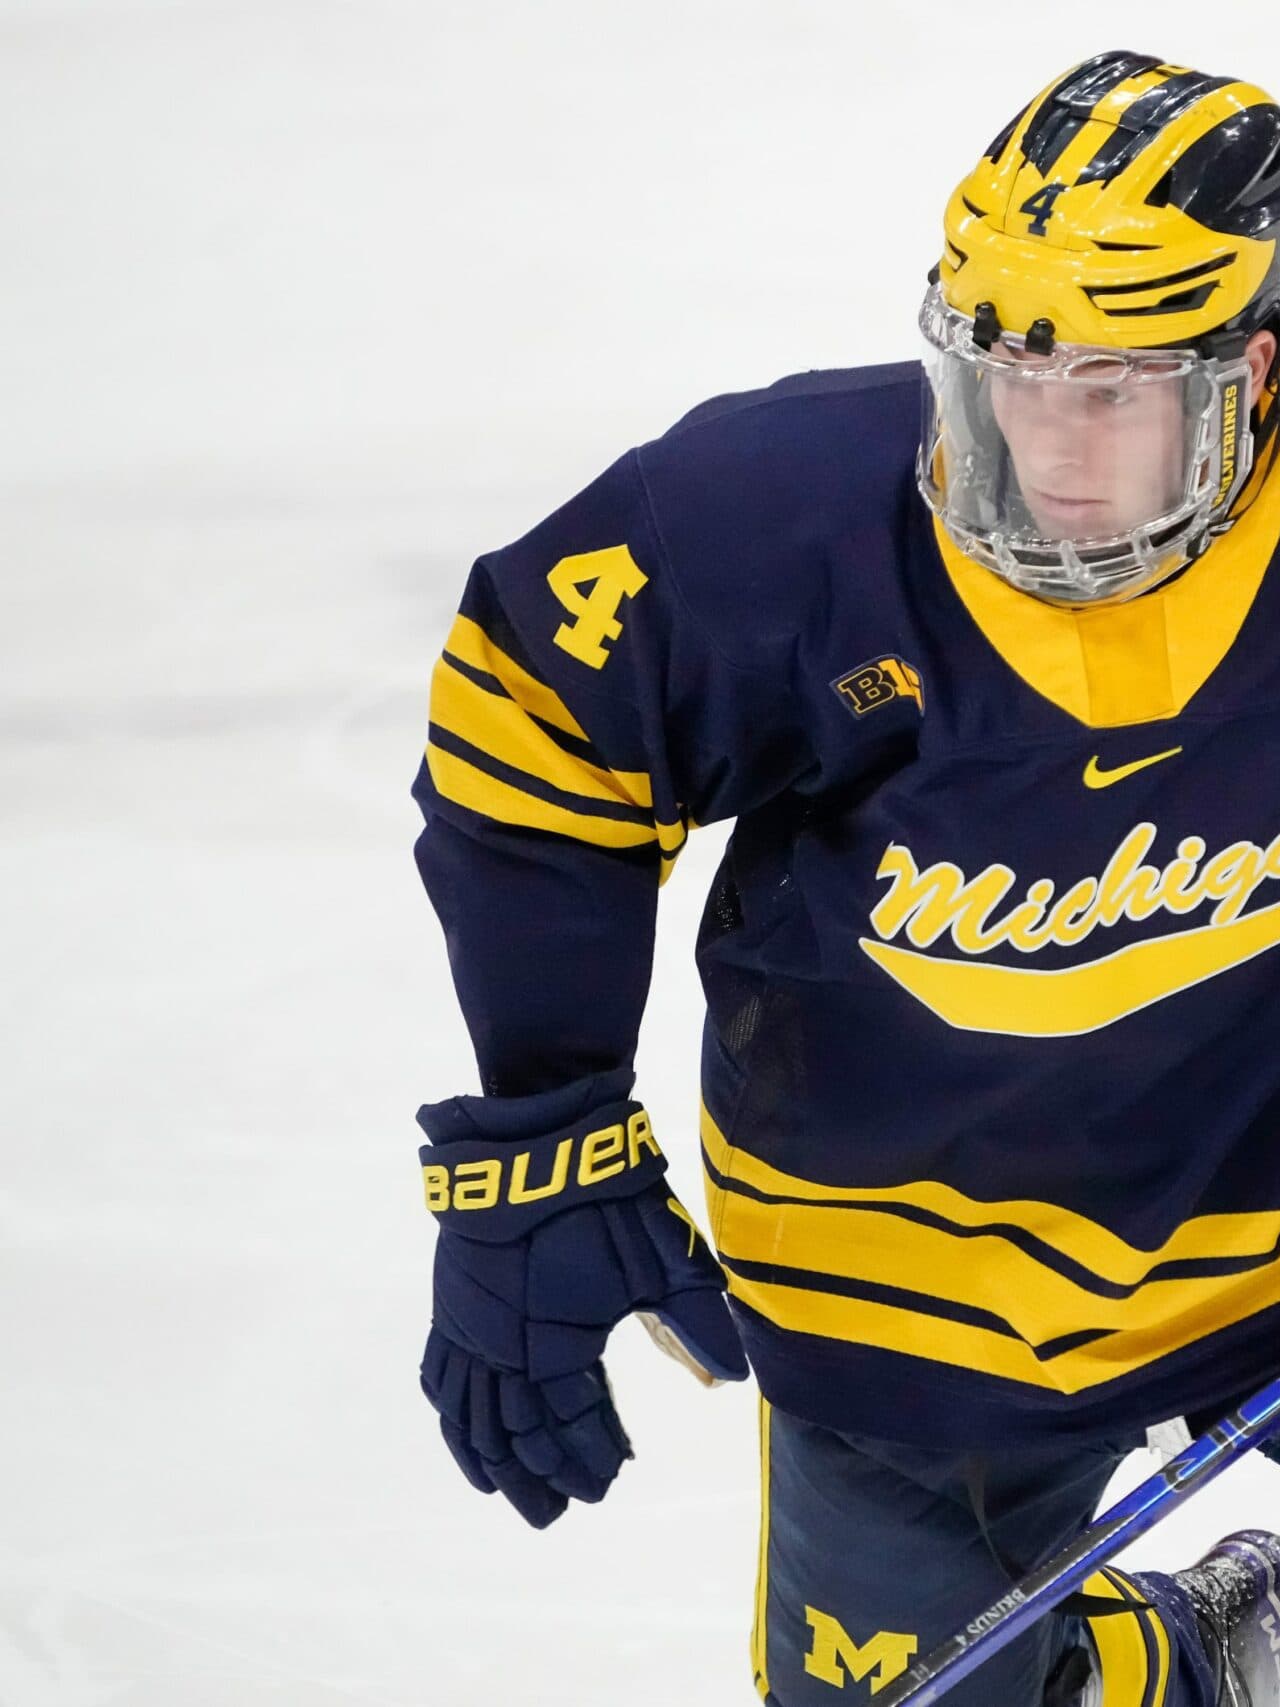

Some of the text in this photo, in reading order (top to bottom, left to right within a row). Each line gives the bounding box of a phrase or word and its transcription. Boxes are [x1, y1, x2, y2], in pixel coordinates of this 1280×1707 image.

[1019, 182, 1069, 236] 4
[1212, 384, 1238, 507] WOLVERINES
[546, 543, 649, 670] 4
[804, 1604, 918, 1694] M
